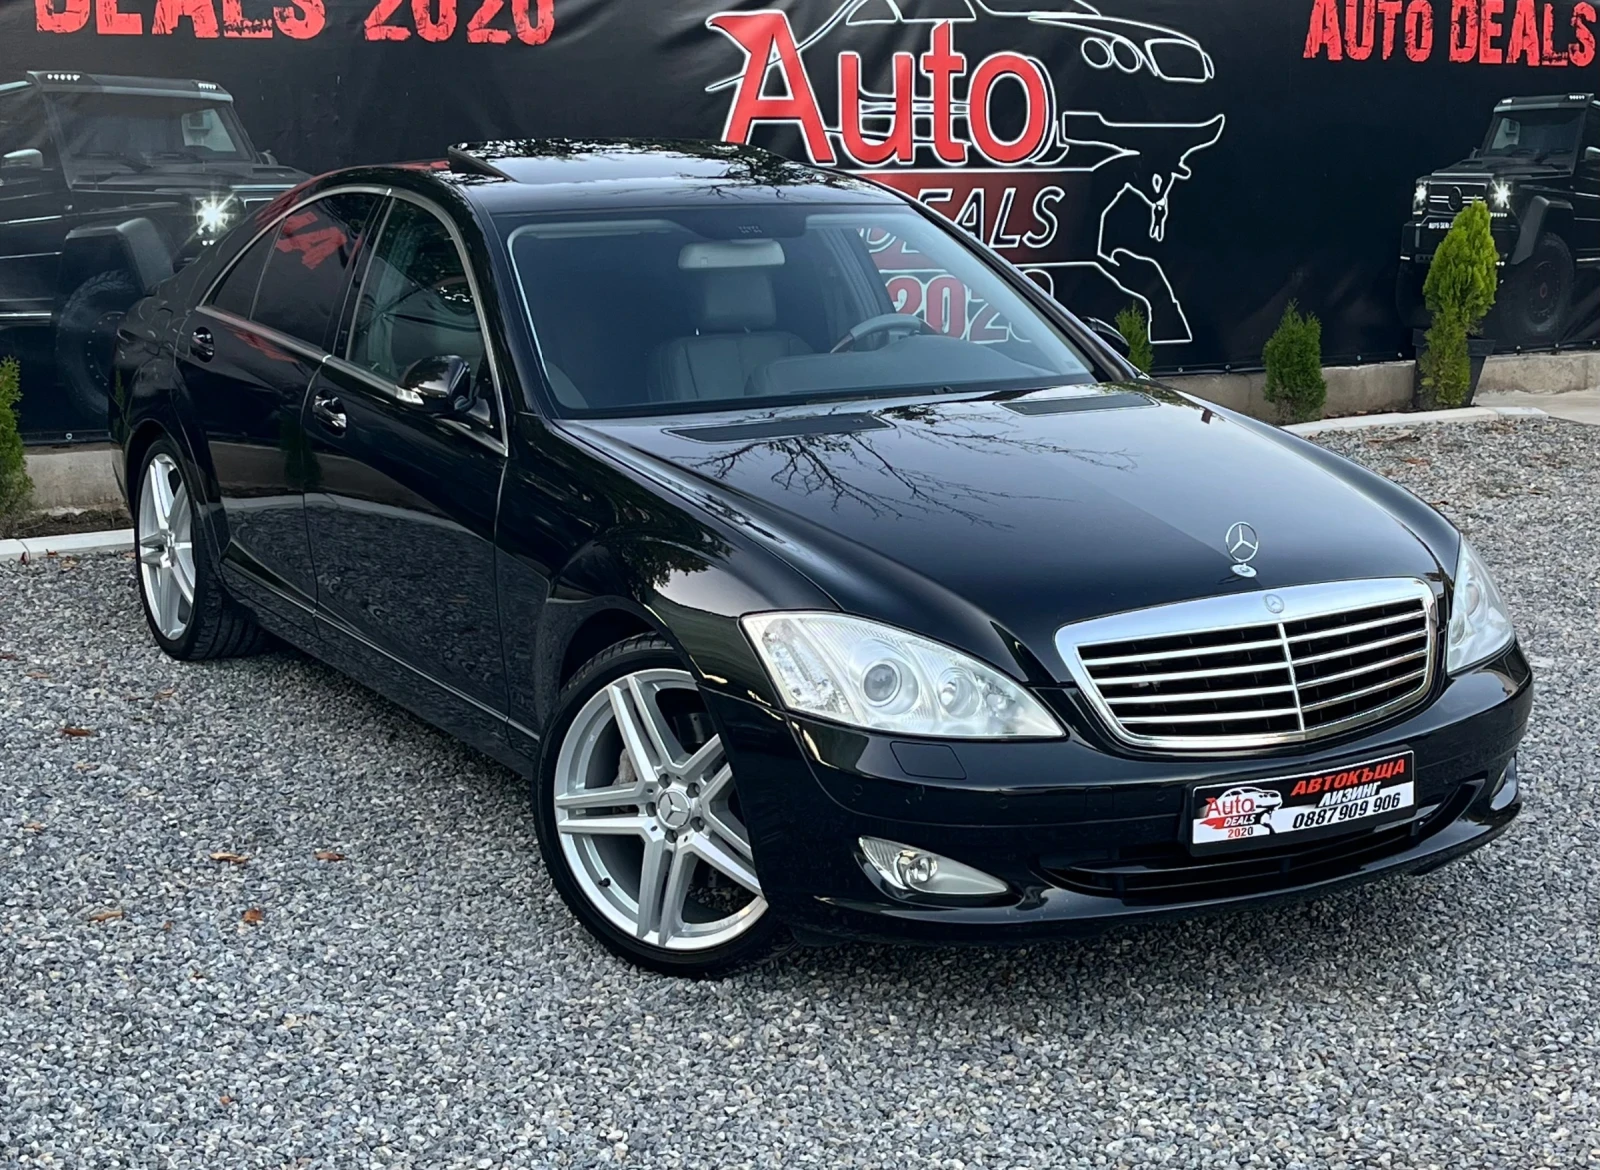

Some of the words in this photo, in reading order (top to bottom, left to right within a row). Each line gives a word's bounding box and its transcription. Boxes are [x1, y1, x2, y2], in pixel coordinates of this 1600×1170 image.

[1303, 0, 1433, 62] AUTO
[1450, 0, 1597, 66] DEALS
[706, 9, 1047, 165] Auto
[1290, 759, 1405, 796] АВТОКЪЩА
[1205, 795, 1255, 818] Auto
[1318, 782, 1382, 808] ЛИЗИНГ
[1373, 793, 1401, 813] 906
[1223, 815, 1257, 827] DEALS
[1227, 826, 1254, 838] 2020
